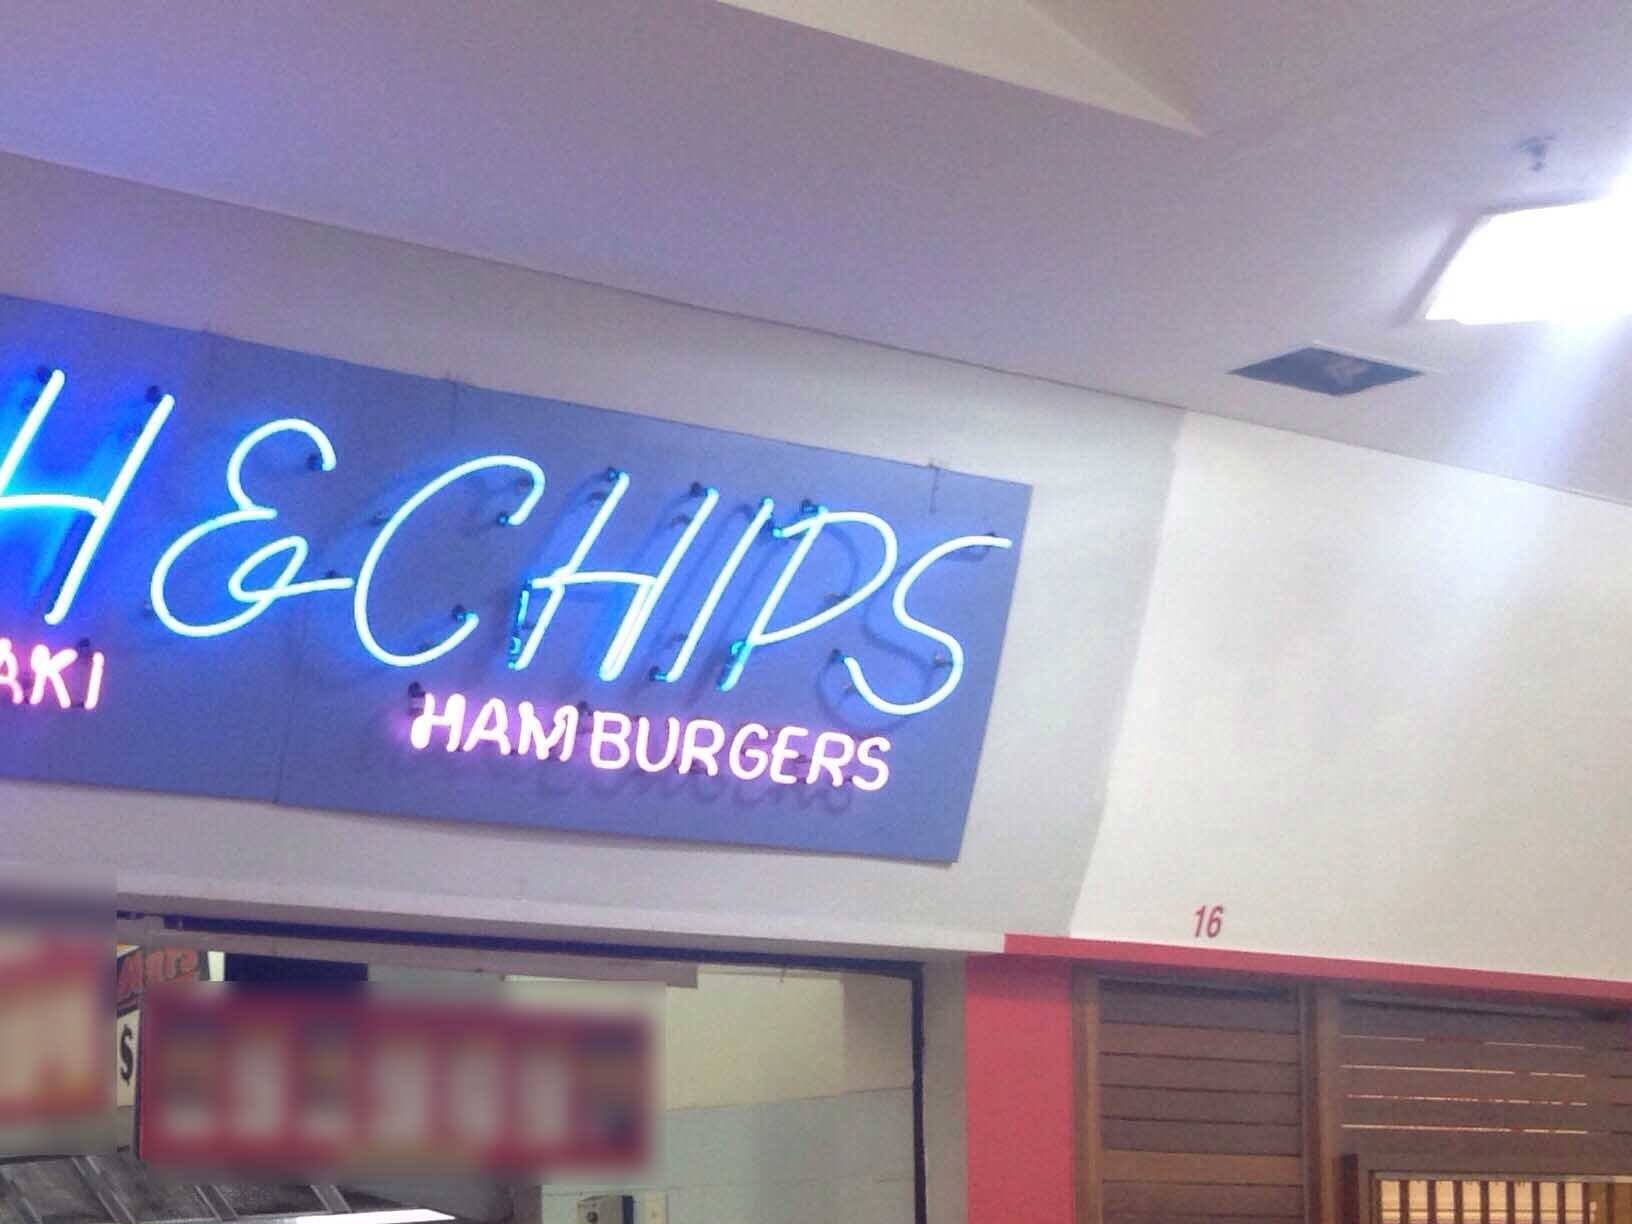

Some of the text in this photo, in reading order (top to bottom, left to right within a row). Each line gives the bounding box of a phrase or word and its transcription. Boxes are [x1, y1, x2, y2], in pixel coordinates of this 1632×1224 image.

[150, 416, 354, 638] &
[353, 454, 1013, 716] CHIPS
[409, 692, 892, 791] HAMBURGERS
[1193, 904, 1225, 939] 16
